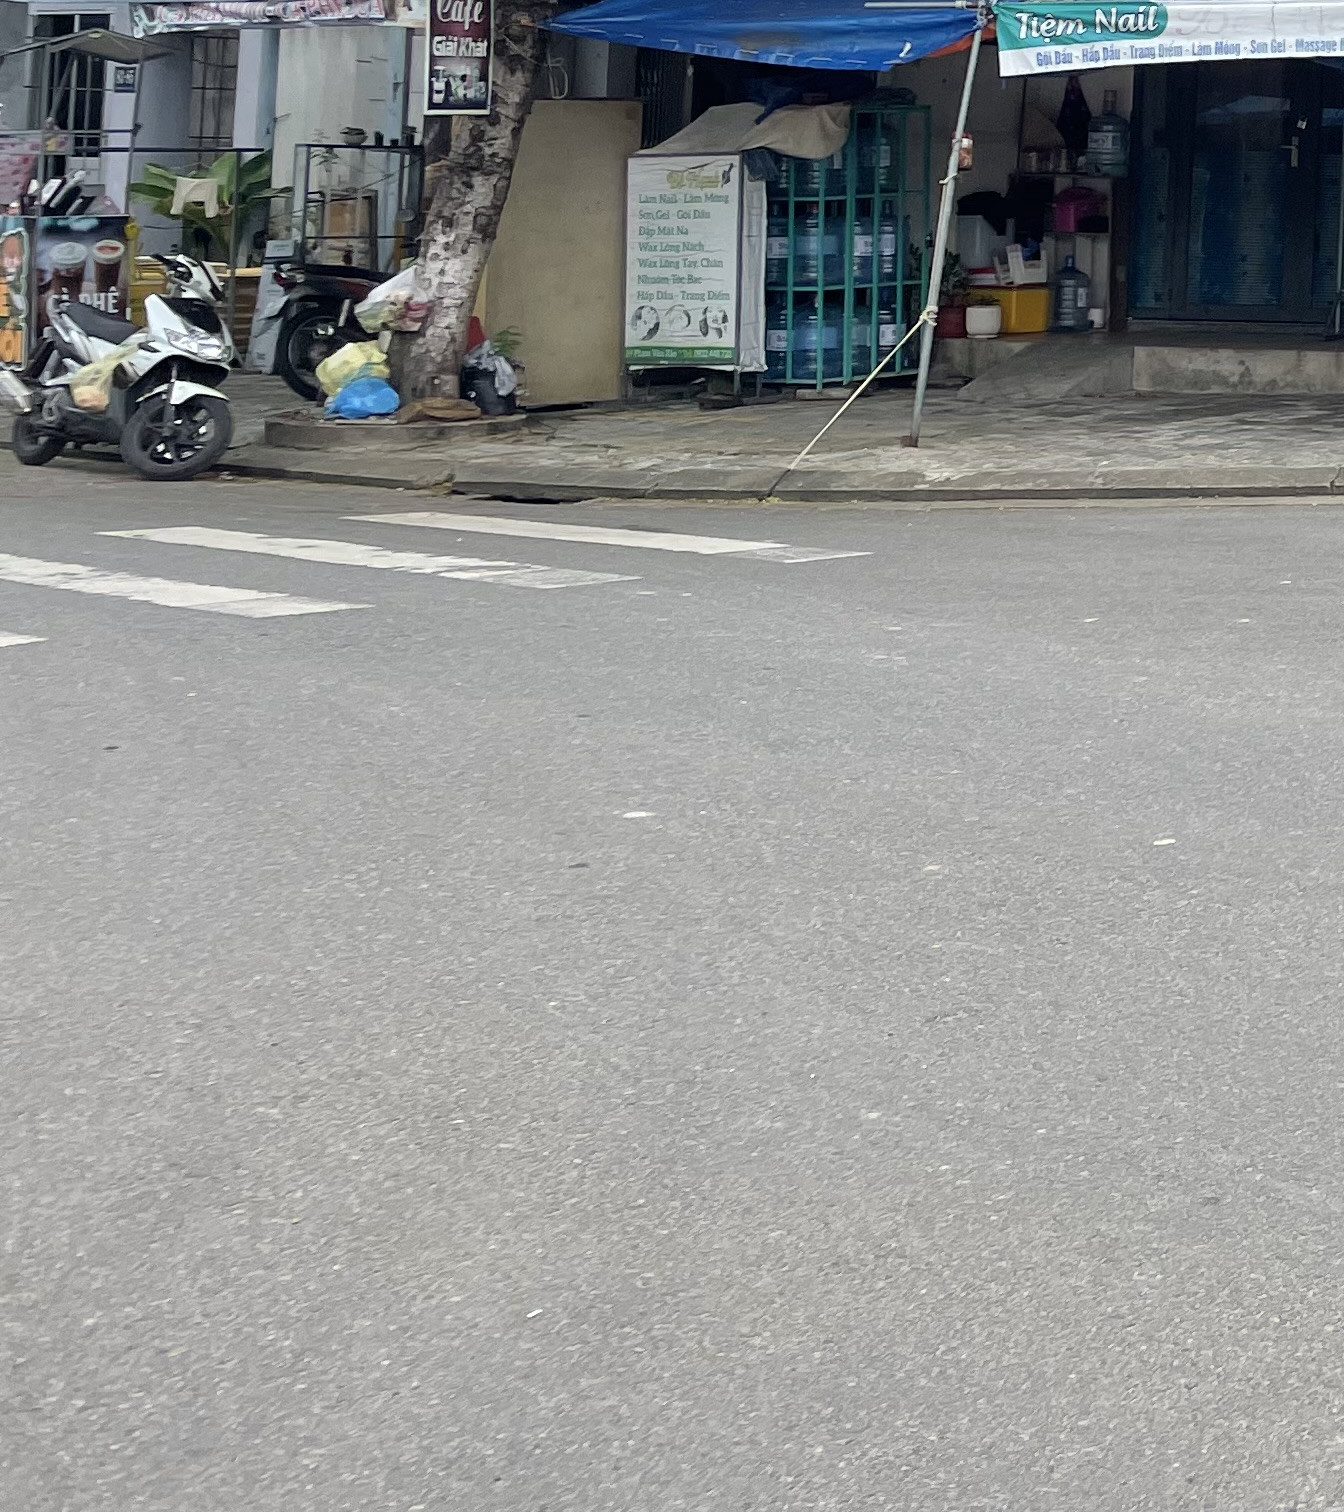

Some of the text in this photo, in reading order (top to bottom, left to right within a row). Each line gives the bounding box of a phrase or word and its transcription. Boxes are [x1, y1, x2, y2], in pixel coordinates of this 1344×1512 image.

[1015, 12, 1087, 43] Tiệm
[1095, 5, 1159, 34] Nail
[432, 35, 488, 58] Giải Khát
[1129, 44, 1156, 60] Trang
[1270, 38, 1286, 54] Gel
[1294, 38, 1337, 54] Massage
